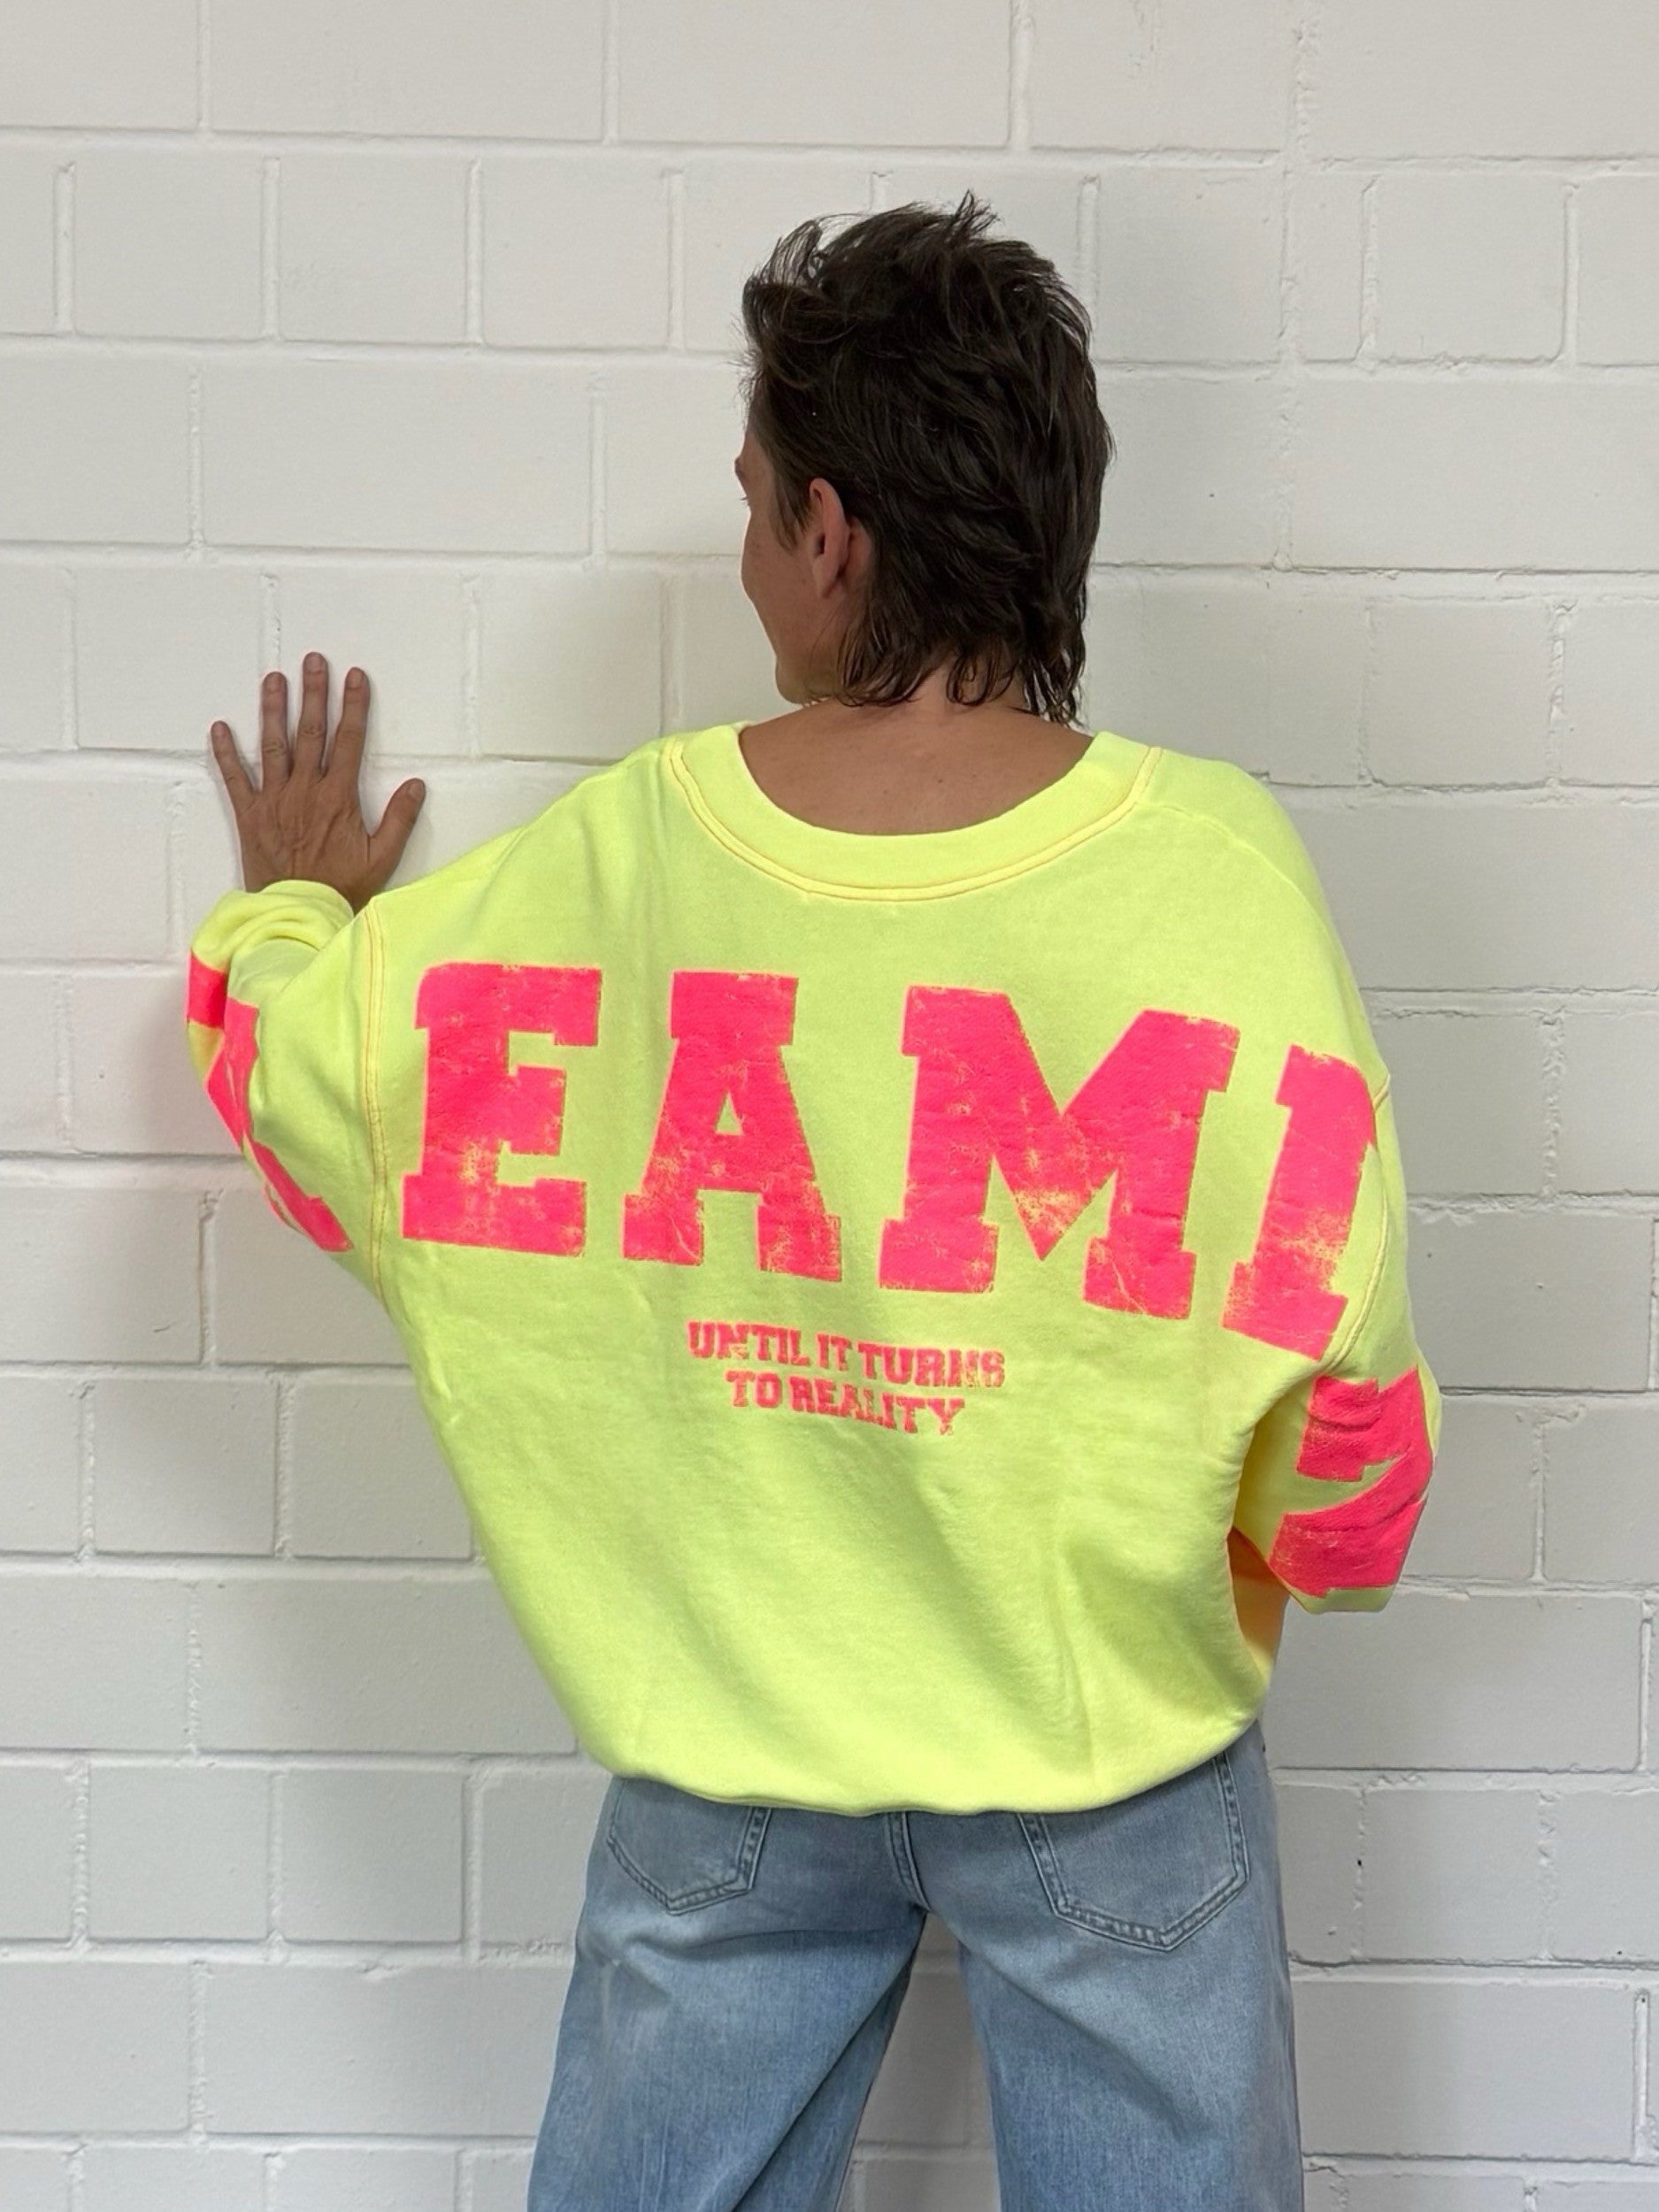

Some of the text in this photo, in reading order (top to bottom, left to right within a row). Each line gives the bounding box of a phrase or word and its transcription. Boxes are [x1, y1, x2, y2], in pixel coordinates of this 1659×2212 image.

[687, 1321, 1004, 1386] UNTIL IT TURNS
[726, 1370, 964, 1434] TO REALITY
